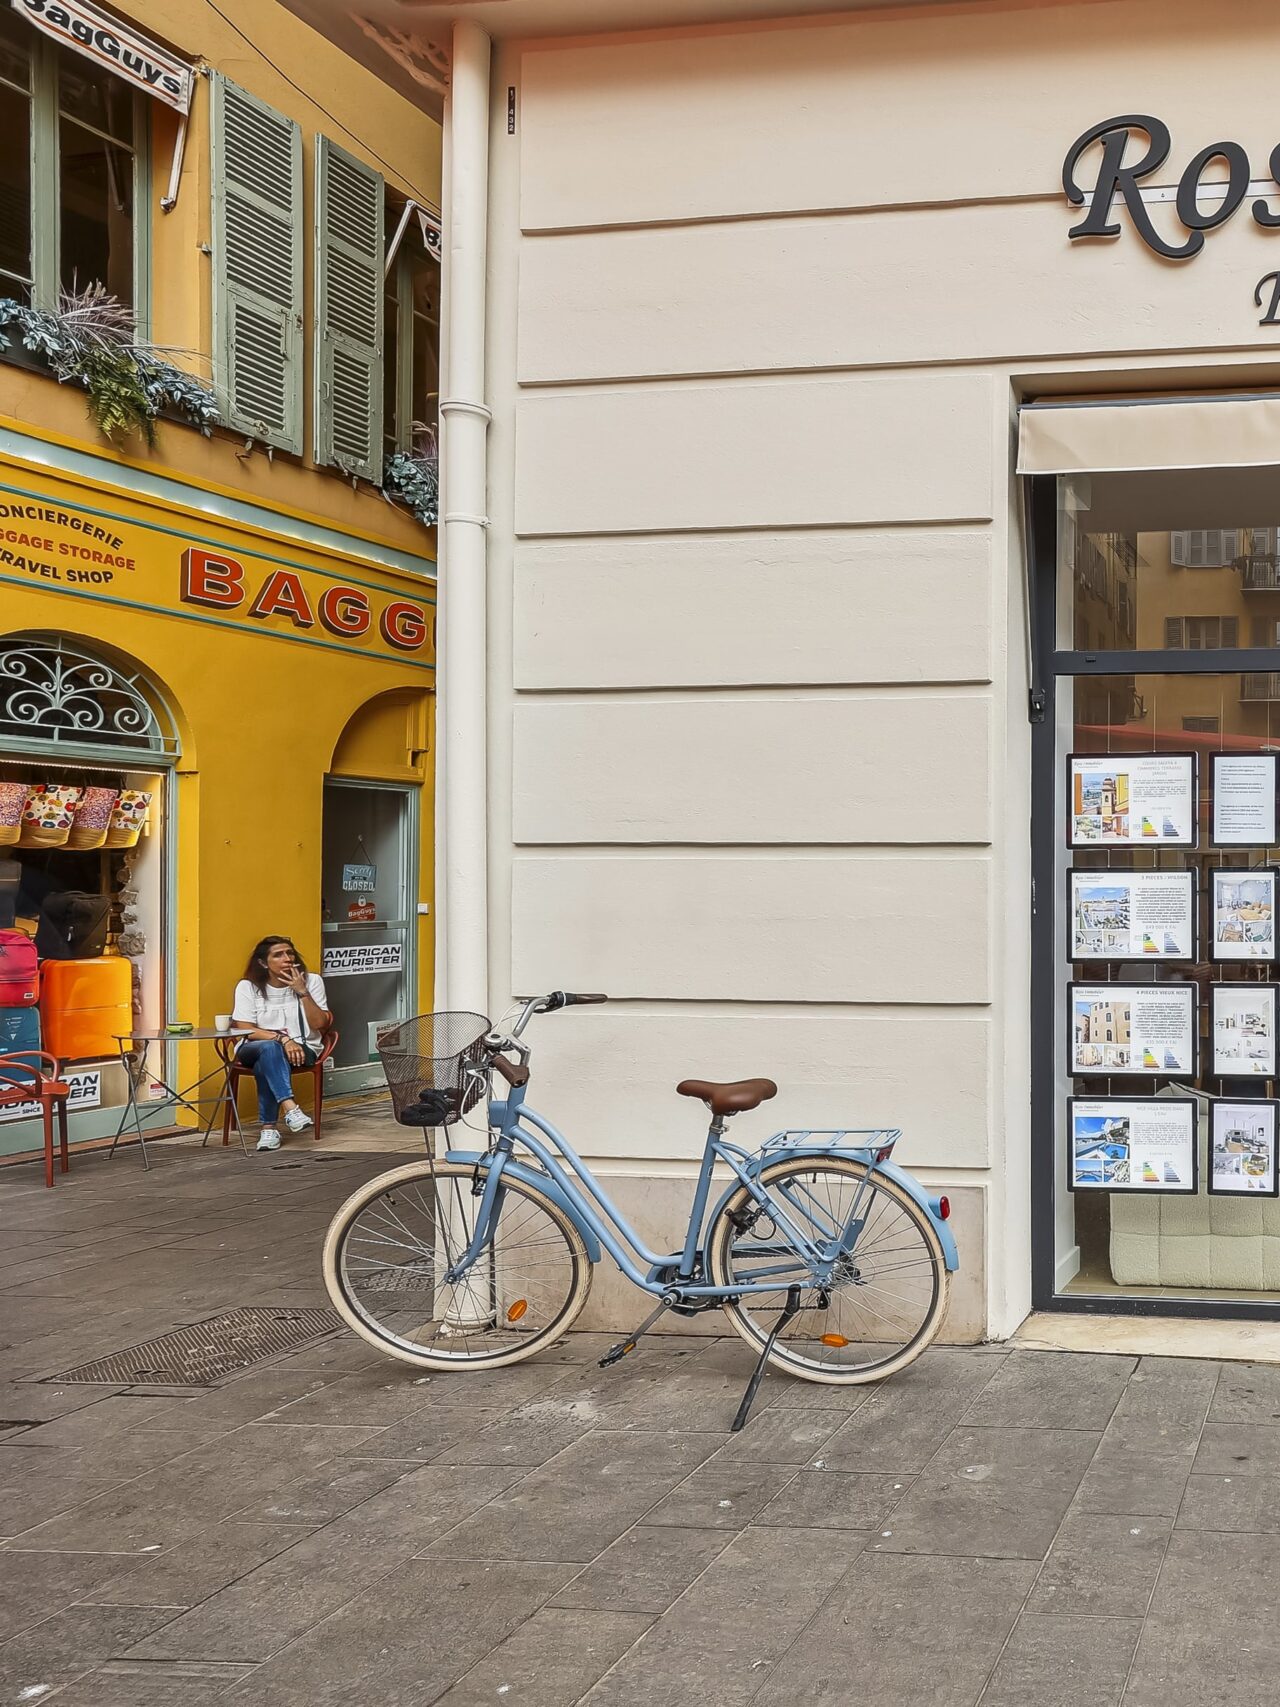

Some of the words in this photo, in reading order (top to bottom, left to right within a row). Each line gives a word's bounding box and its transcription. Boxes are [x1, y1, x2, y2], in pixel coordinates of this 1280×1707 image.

[58, 541, 136, 572] STORAGE
[66, 568, 114, 584] SHOP
[180, 546, 437, 651] BAGG
[324, 946, 401, 960] AMERICAN
[322, 955, 400, 969] TOURISTER
[22, 1106, 41, 1114] SINCE
